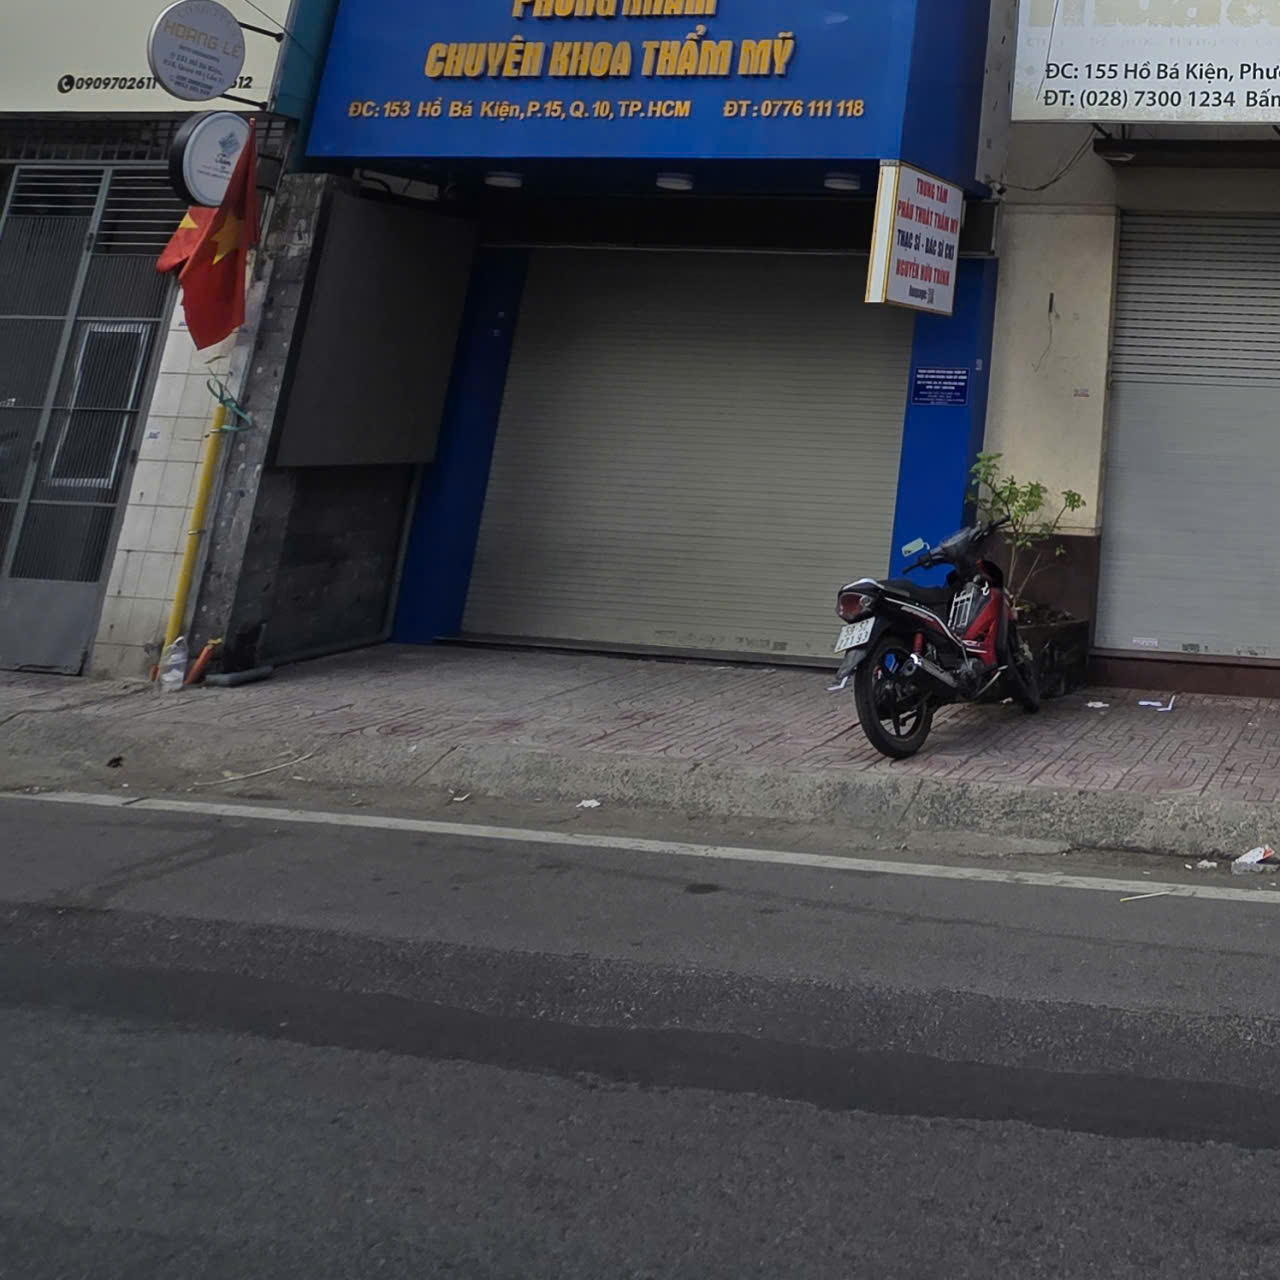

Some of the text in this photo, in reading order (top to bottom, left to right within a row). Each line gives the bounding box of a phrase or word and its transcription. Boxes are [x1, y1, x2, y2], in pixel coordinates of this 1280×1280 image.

[424, 24, 794, 77] CHUYÊN KHOA THẨM MỸ
[1045, 63, 1079, 79] ĐC:
[1085, 63, 1118, 80] 155
[1124, 59, 1151, 80] Hồ
[1156, 62, 1180, 80] Bá
[1186, 62, 1234, 84] Kiện,
[75, 77, 157, 90] 0909702611
[348, 100, 380, 118] ĐC:
[383, 100, 410, 118] 153
[417, 97, 443, 118] Hồ
[448, 100, 473, 118] Bá
[760, 100, 802, 117] 0776
[806, 100, 833, 117] 111
[836, 100, 865, 117] 118
[1043, 91, 1075, 107] ĐT:
[1080, 90, 1128, 109] (028)
[1134, 91, 1182, 107] 7300
[1189, 90, 1235, 107] 1234
